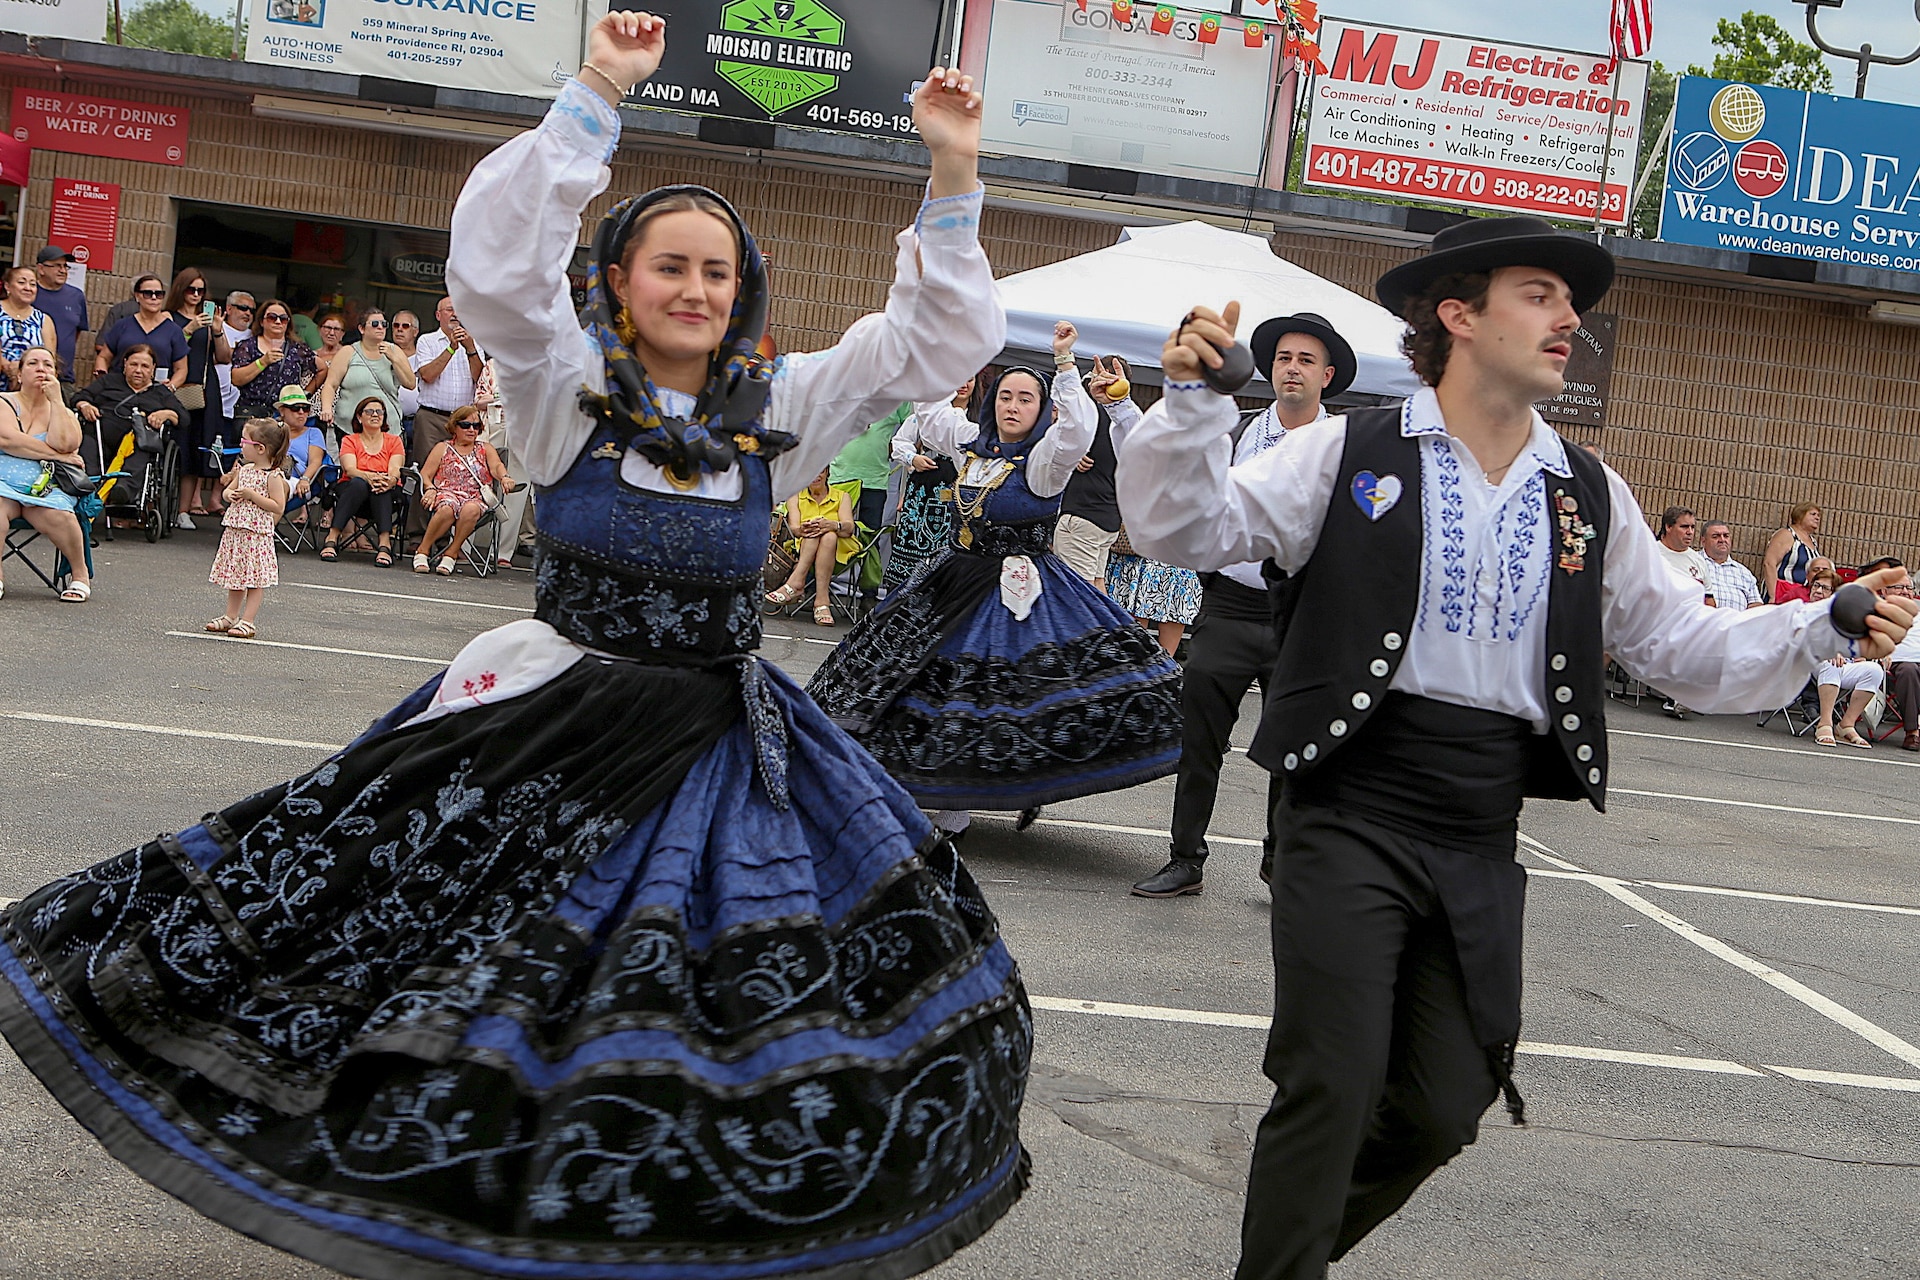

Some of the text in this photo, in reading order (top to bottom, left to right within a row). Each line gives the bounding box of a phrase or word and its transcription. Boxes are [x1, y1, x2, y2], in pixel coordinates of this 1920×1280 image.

[362, 18, 494, 42] 959 Mineral Spring Ave.
[270, 48, 334, 64] BUSINESS
[351, 31, 504, 58] North Providence RI, 02904
[706, 34, 852, 72] MOISAO ELEKTRIC
[387, 50, 462, 66] 401-205-2597
[1046, 44, 1062, 55] The
[1065, 48, 1088, 58] Taste
[1090, 50, 1102, 62] of
[1144, 57, 1166, 68] Here
[1168, 62, 1179, 70] In
[1179, 63, 1216, 76] America
[1330, 28, 1440, 91] MJ
[1466, 44, 1610, 86] Electric &
[774, 80, 802, 92] 2013
[1084, 68, 1173, 88] 800-333-2344
[641, 84, 684, 102] AND
[690, 88, 720, 108] MA
[1053, 90, 1086, 100] THURBER
[1086, 95, 1130, 106] BOULEVARD
[1134, 102, 1178, 114] SMITHFIELD,
[1186, 108, 1208, 118] 02917
[1083, 85, 1108, 94] HENRY
[1108, 88, 1150, 100] GONSALVES
[1150, 94, 1186, 105] COMPANY
[1441, 70, 1630, 117] Refrigeration
[25, 96, 62, 113] BEER
[78, 102, 117, 120] SOFT
[120, 108, 177, 127] DRINKS
[1029, 110, 1064, 120] Facebook
[1320, 86, 1634, 139] Commercial Residential Service/Design/Intall
[46, 116, 98, 135] WATER
[114, 125, 152, 142] CAFE
[1083, 115, 1230, 142] www.facebook.com/gonsalvesfoods
[1324, 106, 1625, 158] Air Conditioning Heating Refrigeraton
[1329, 126, 1348, 140] Ice
[1354, 130, 1420, 150] Machines
[1445, 140, 1495, 159] Walk-In
[64, 188, 110, 200] SOFT DRINKS
[74, 184, 92, 192] BEER
[1314, 152, 1621, 212] 401-487-5770 508-222-0593
[1674, 190, 1840, 238] Warehouse
[396, 259, 446, 278] BRICELT
[1574, 326, 1604, 356] USITANA
[1548, 394, 1602, 407] ORTUGUESA
[1562, 381, 1596, 394] RVINDO
[1550, 406, 1560, 414] DE
[1563, 407, 1578, 416] 1993
